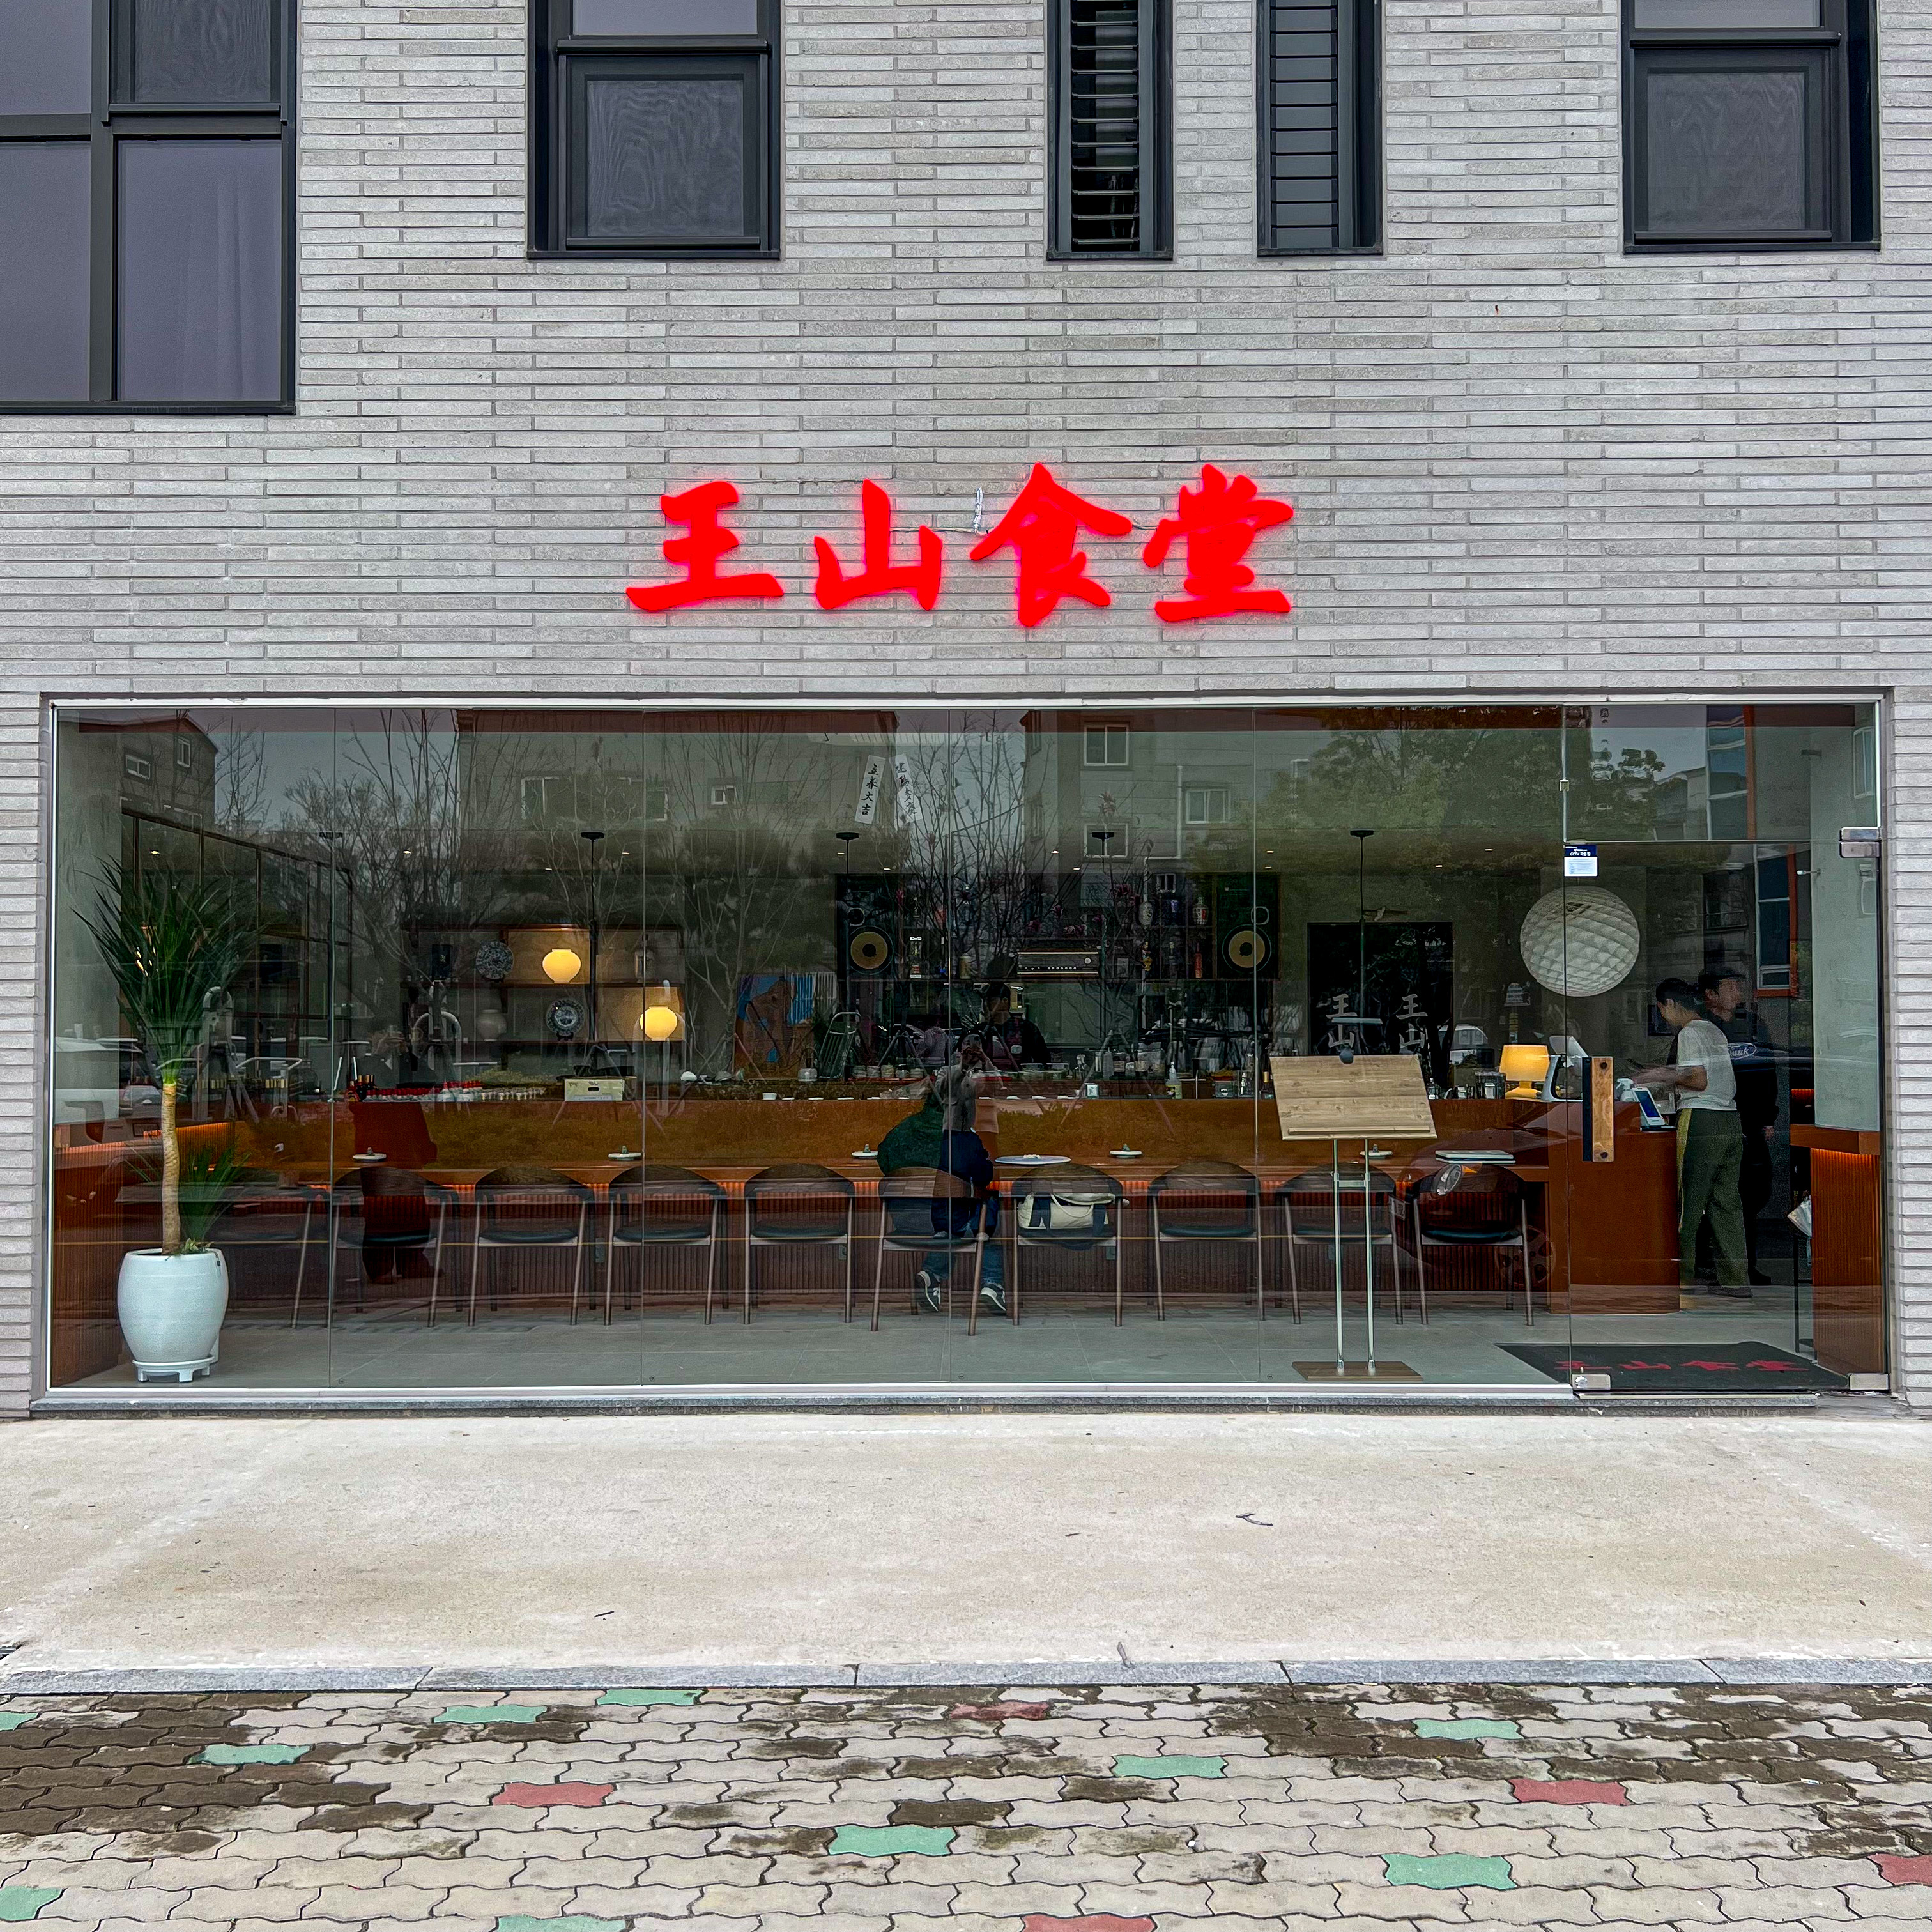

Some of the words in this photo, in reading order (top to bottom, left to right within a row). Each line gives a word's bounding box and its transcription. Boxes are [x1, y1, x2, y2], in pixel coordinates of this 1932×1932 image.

[626, 461, 1294, 627] 王山食堂
[861, 763, 879, 816] 立春大吉
[1326, 993, 1358, 1048] 王山
[1395, 993, 1428, 1049] 王山
